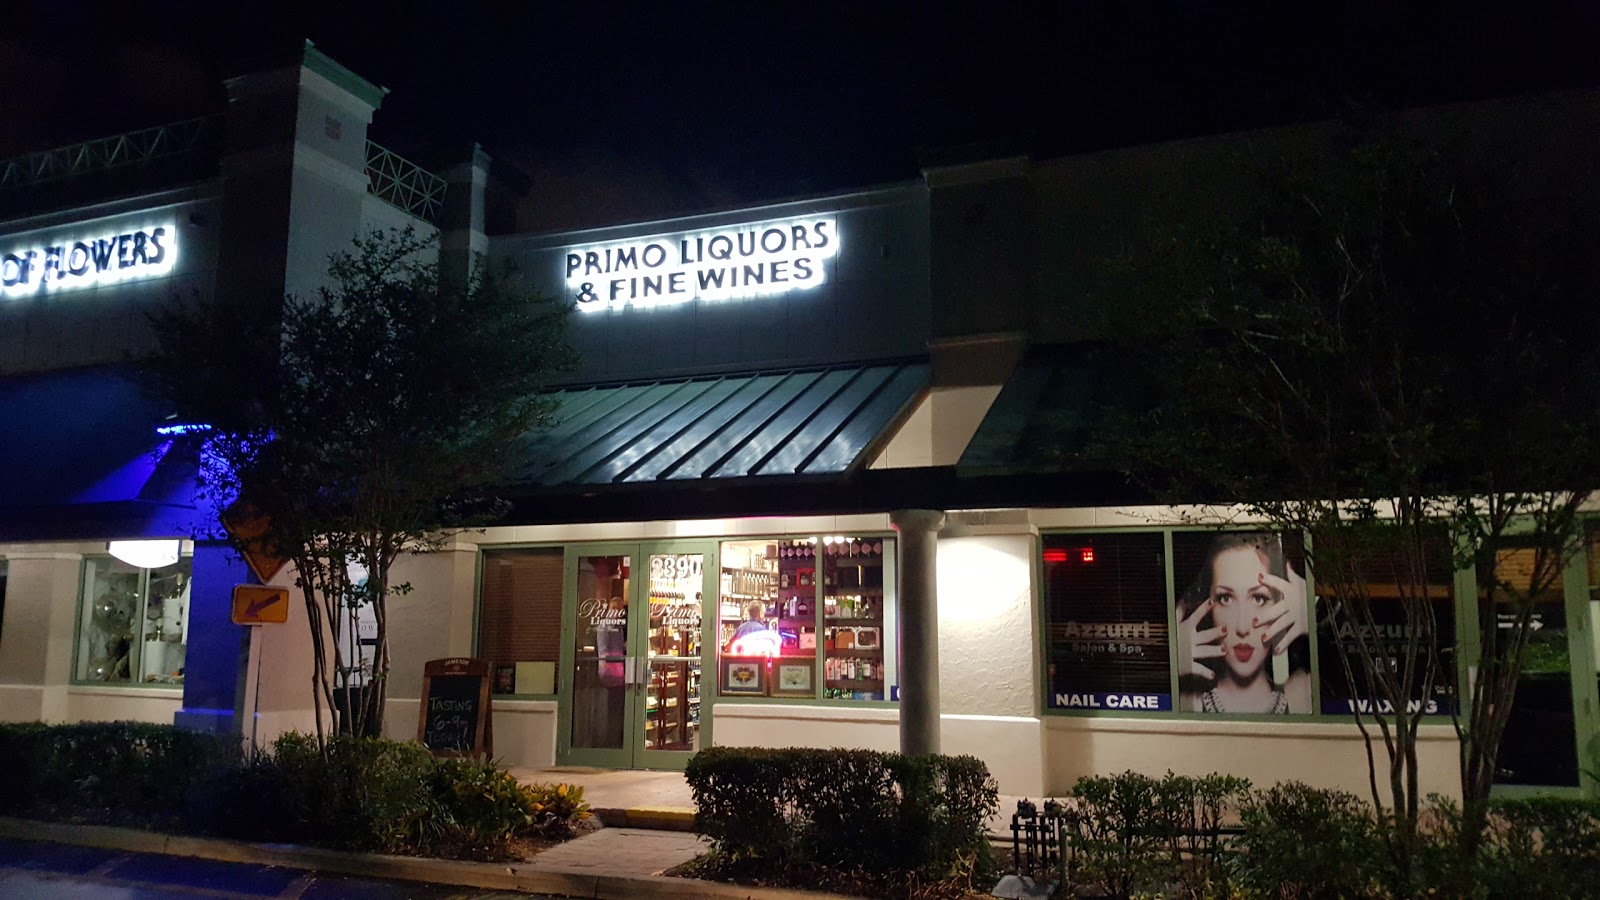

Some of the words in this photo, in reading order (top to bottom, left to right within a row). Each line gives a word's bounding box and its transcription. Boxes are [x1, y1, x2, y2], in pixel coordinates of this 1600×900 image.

[1, 250, 38, 287] OF
[43, 227, 166, 282] FLOWERS
[566, 244, 667, 278] PRIMO
[681, 221, 829, 265] LIQUORS
[575, 282, 600, 303] &
[609, 272, 686, 301] FINE
[697, 257, 813, 291] WINES
[579, 597, 627, 618] Primo
[590, 616, 627, 628] Liquors
[1064, 620, 1149, 638] Azzurri
[430, 696, 472, 712] TASTING
[1055, 693, 1100, 707] NAIL
[1106, 694, 1159, 709] CARE
[1347, 699, 1438, 714] WAXNG
